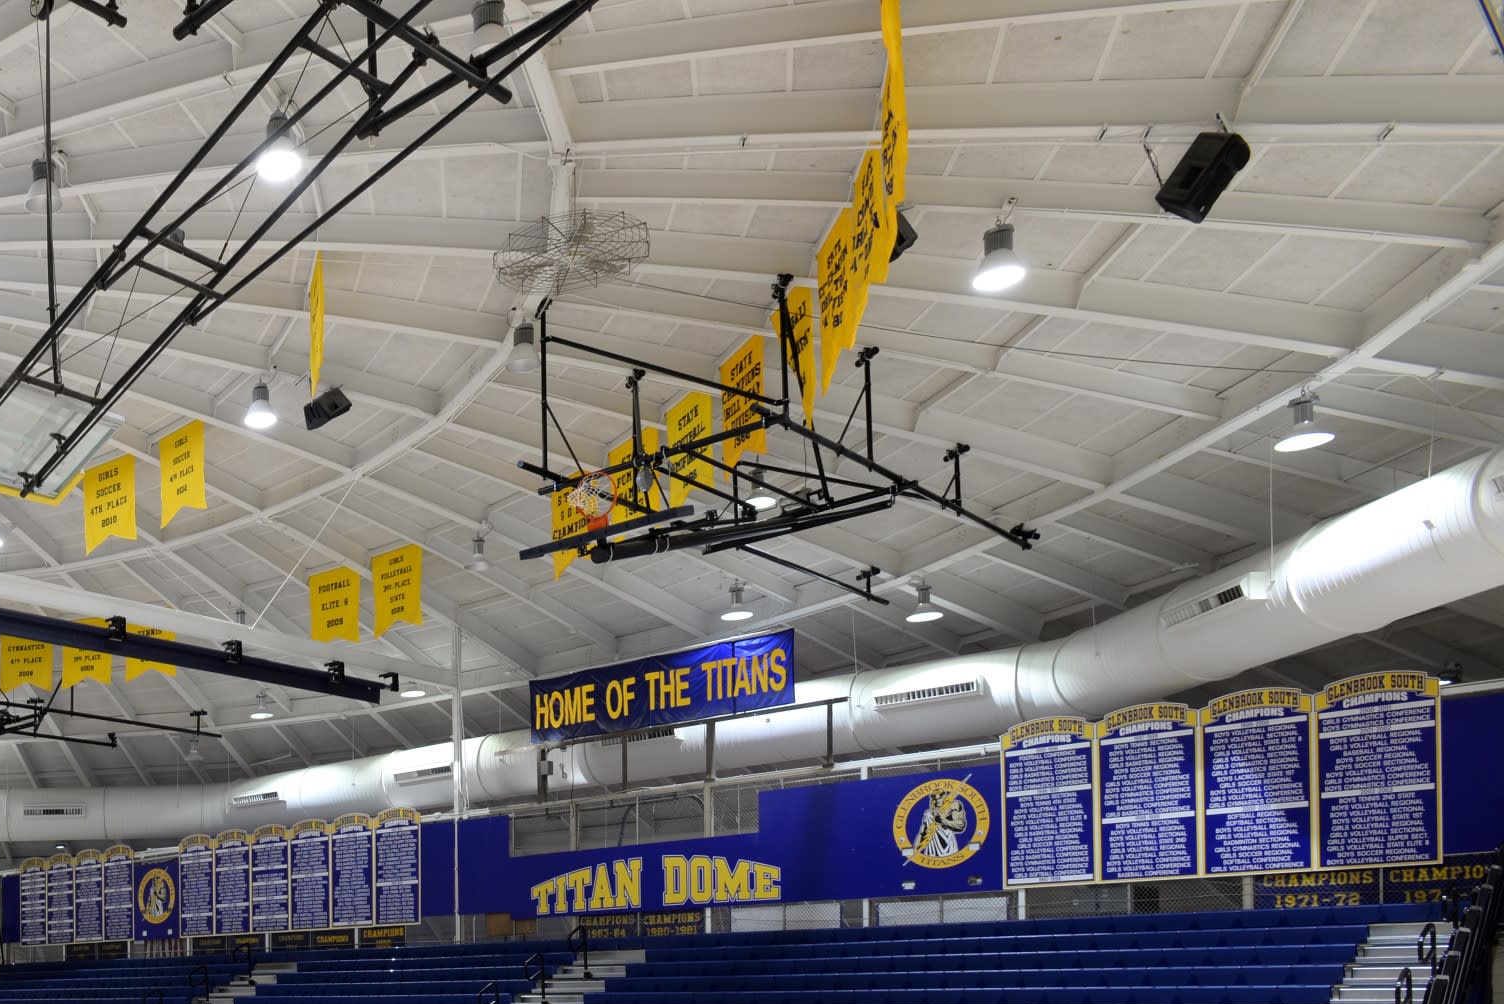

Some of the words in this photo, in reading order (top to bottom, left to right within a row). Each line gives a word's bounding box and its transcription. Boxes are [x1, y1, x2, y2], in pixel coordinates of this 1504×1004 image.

[730, 350, 753, 382] STATE
[678, 404, 699, 431] STATE
[175, 436, 188, 448] GIRLS
[173, 451, 190, 466] SOCCER
[98, 467, 119, 482] GIRLS
[180, 465, 194, 478] PLACE
[96, 482, 121, 499] SOCCER
[90, 504, 103, 516] 4TH
[107, 495, 127, 510] PLACE
[101, 515, 117, 528] 2010
[389, 555, 404, 566] GIRLS
[381, 565, 413, 581] VOLLEYBALL
[318, 579, 350, 594] FOOTBALL
[395, 578, 411, 589] PLACE
[321, 600, 339, 611] ELITE
[389, 593, 405, 603] STATE
[7, 644, 45, 652] GYMNASTICS
[535, 683, 596, 730] HOME
[605, 676, 635, 720] OF
[645, 667, 691, 711] THE
[701, 647, 787, 702] TITANS
[1328, 675, 1385, 701] GLENBROOK
[1391, 674, 1423, 689] SOUTH
[1212, 692, 1264, 716] GLENBROOK
[1268, 691, 1298, 705] SOUTH
[1343, 691, 1408, 708] CHAMPIONS
[1107, 707, 1154, 729] GLENBROOK
[1158, 705, 1185, 720] SOUTH
[1225, 708, 1285, 723] CHAMPIONS
[1342, 713, 1384, 722] GYMNASTICS
[1386, 707, 1431, 717] CONFERENCE
[1011, 720, 1055, 742] GLENBROOK
[1058, 718, 1083, 733] SOUTH
[1119, 721, 1173, 736] CHAMPIONS
[1349, 734, 1387, 742] VOLLEYBALL
[1390, 730, 1422, 738] REGIONAL
[1022, 734, 1072, 748] CHAMPIONS
[1343, 749, 1374, 757] BASEBALL
[1376, 745, 1408, 753] REGIONAL
[1217, 775, 1233, 783] BOYS
[1234, 772, 1265, 780] LACROSSE
[896, 781, 954, 829] GLENBROOK
[960, 786, 987, 821] SOUTH
[1347, 836, 1385, 844] VOLLEYBALL
[920, 853, 964, 865] TITANS
[1346, 856, 1383, 864] VOLLEYBALL
[1386, 853, 1430, 861] CONFERENCE
[1263, 870, 1374, 888] CHAMPIONS
[1390, 865, 1484, 883] CHAMPIO
[530, 856, 643, 915] TITAN
[661, 854, 781, 906] DOME
[1274, 893, 1360, 908] 1971-72
[580, 914, 635, 926] CHAMPIONS
[643, 912, 701, 925] CHAMPIONS
[363, 928, 404, 937] CHAMPIONS
